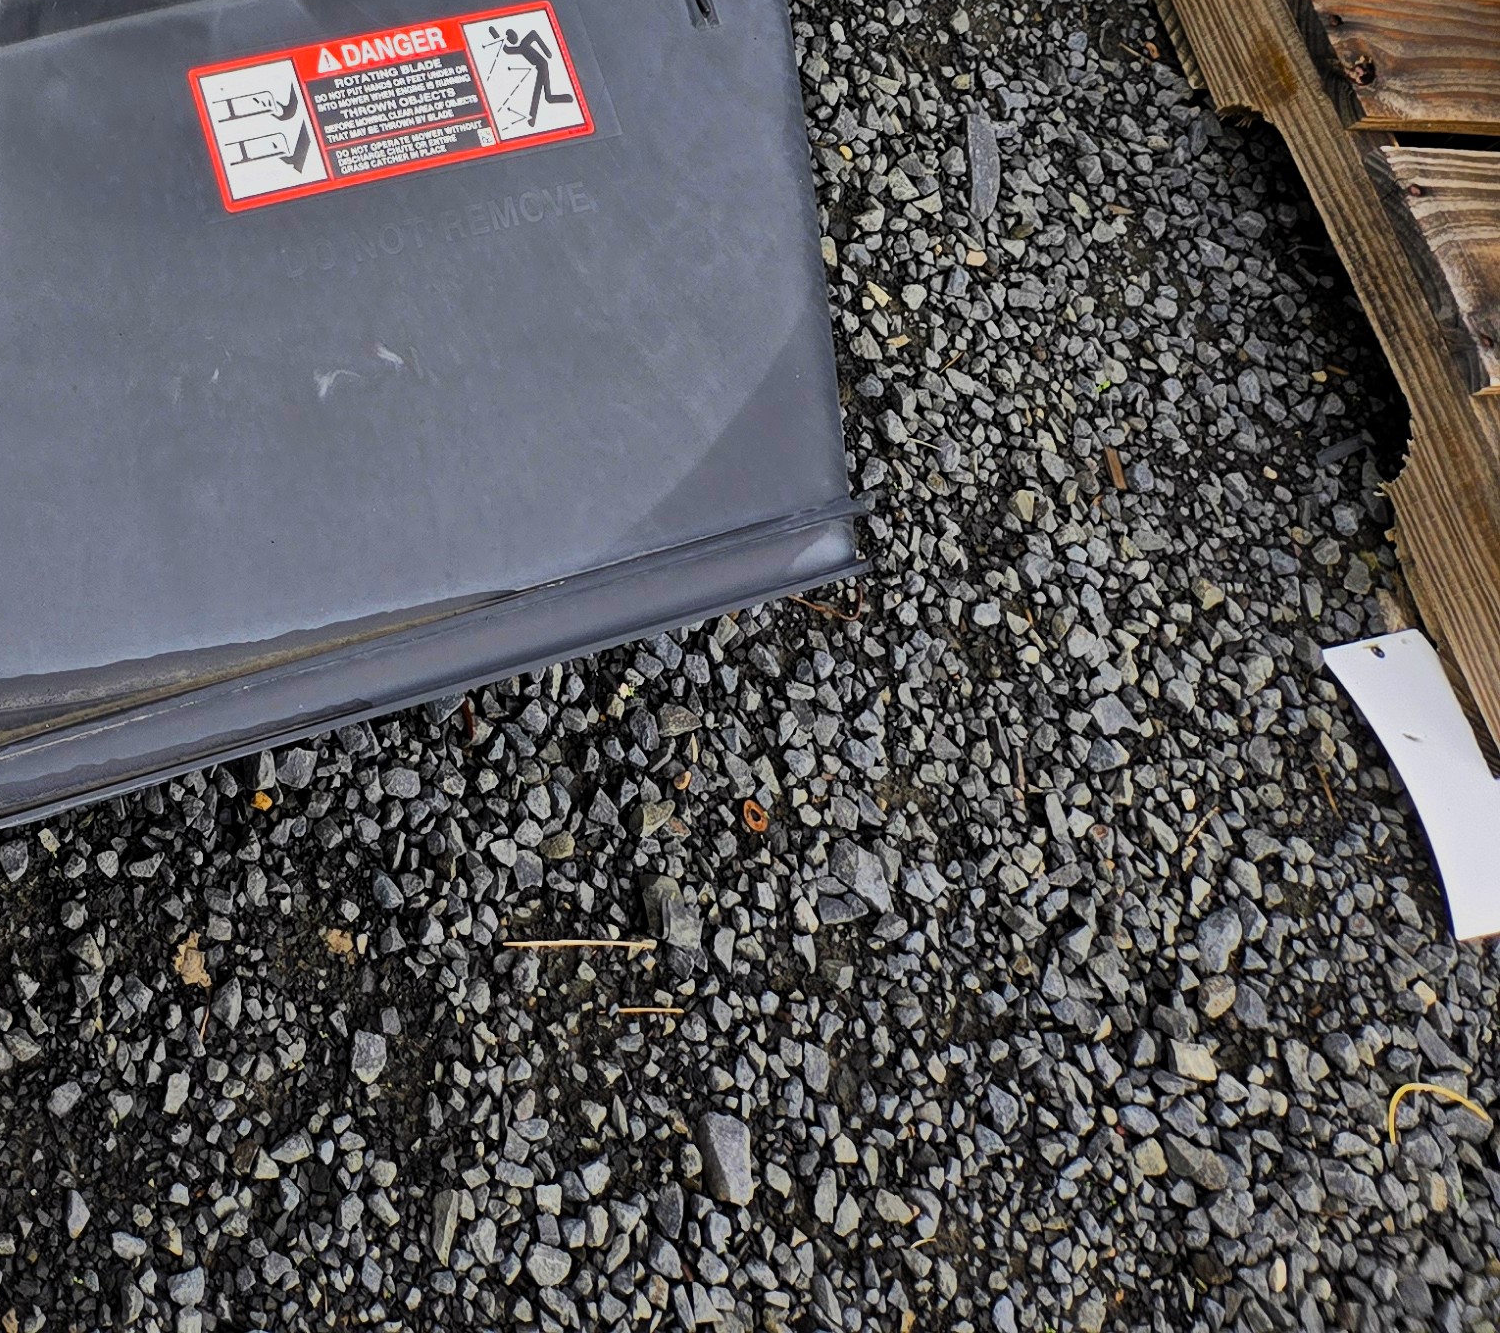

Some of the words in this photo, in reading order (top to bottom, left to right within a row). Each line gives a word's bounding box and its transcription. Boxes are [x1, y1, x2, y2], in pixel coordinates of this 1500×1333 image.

[340, 27, 446, 66] DANGER
[314, 92, 327, 102] DO
[328, 89, 345, 99] NOT
[346, 86, 363, 96] PUT
[364, 80, 391, 92] HANDS
[392, 77, 405, 86] OR
[406, 74, 425, 84] FEET
[427, 68, 454, 80] UNDER
[455, 65, 468, 74] OR
[334, 67, 398, 87] ROTATING
[400, 59, 442, 74] BLADE
[317, 100, 337, 111] INTO
[337, 94, 369, 107] MOWER
[370, 89, 394, 100] WHEN
[395, 83, 425, 96] ENGINE
[425, 81, 434, 90] IS
[435, 74, 470, 88] RUNNING
[340, 99, 396, 118] THROWN
[398, 88, 456, 107] OBJECTS
[324, 119, 355, 132] BEFORE
[388, 108, 413, 119] CLEAR
[413, 103, 434, 114] AREA
[434, 101, 444, 110] OF
[444, 95, 478, 108] OBJECTS
[327, 131, 349, 142] THAT
[349, 127, 367, 138] MAY
[367, 125, 379, 134] BE
[379, 118, 415, 132] THROWN
[415, 115, 426, 124] BY
[427, 110, 453, 122] BLADE
[335, 148, 349, 158] DO
[350, 144, 368, 154] NOT
[370, 135, 410, 150] OPERATE
[411, 129, 443, 142] MOWER
[444, 120, 483, 135] WITHOUT
[338, 149, 385, 166] DISCHARGE
[386, 143, 413, 155] CHUTE
[414, 141, 427, 149] OR
[428, 134, 456, 146] ENTIRE
[340, 161, 369, 173] GRASS
[370, 153, 409, 167] CATCHER
[409, 150, 419, 158] IN
[419, 145, 446, 156] PLACE
[279, 237, 339, 279] DO
[350, 215, 433, 262] NOT
[441, 180, 592, 241] REMOVE
